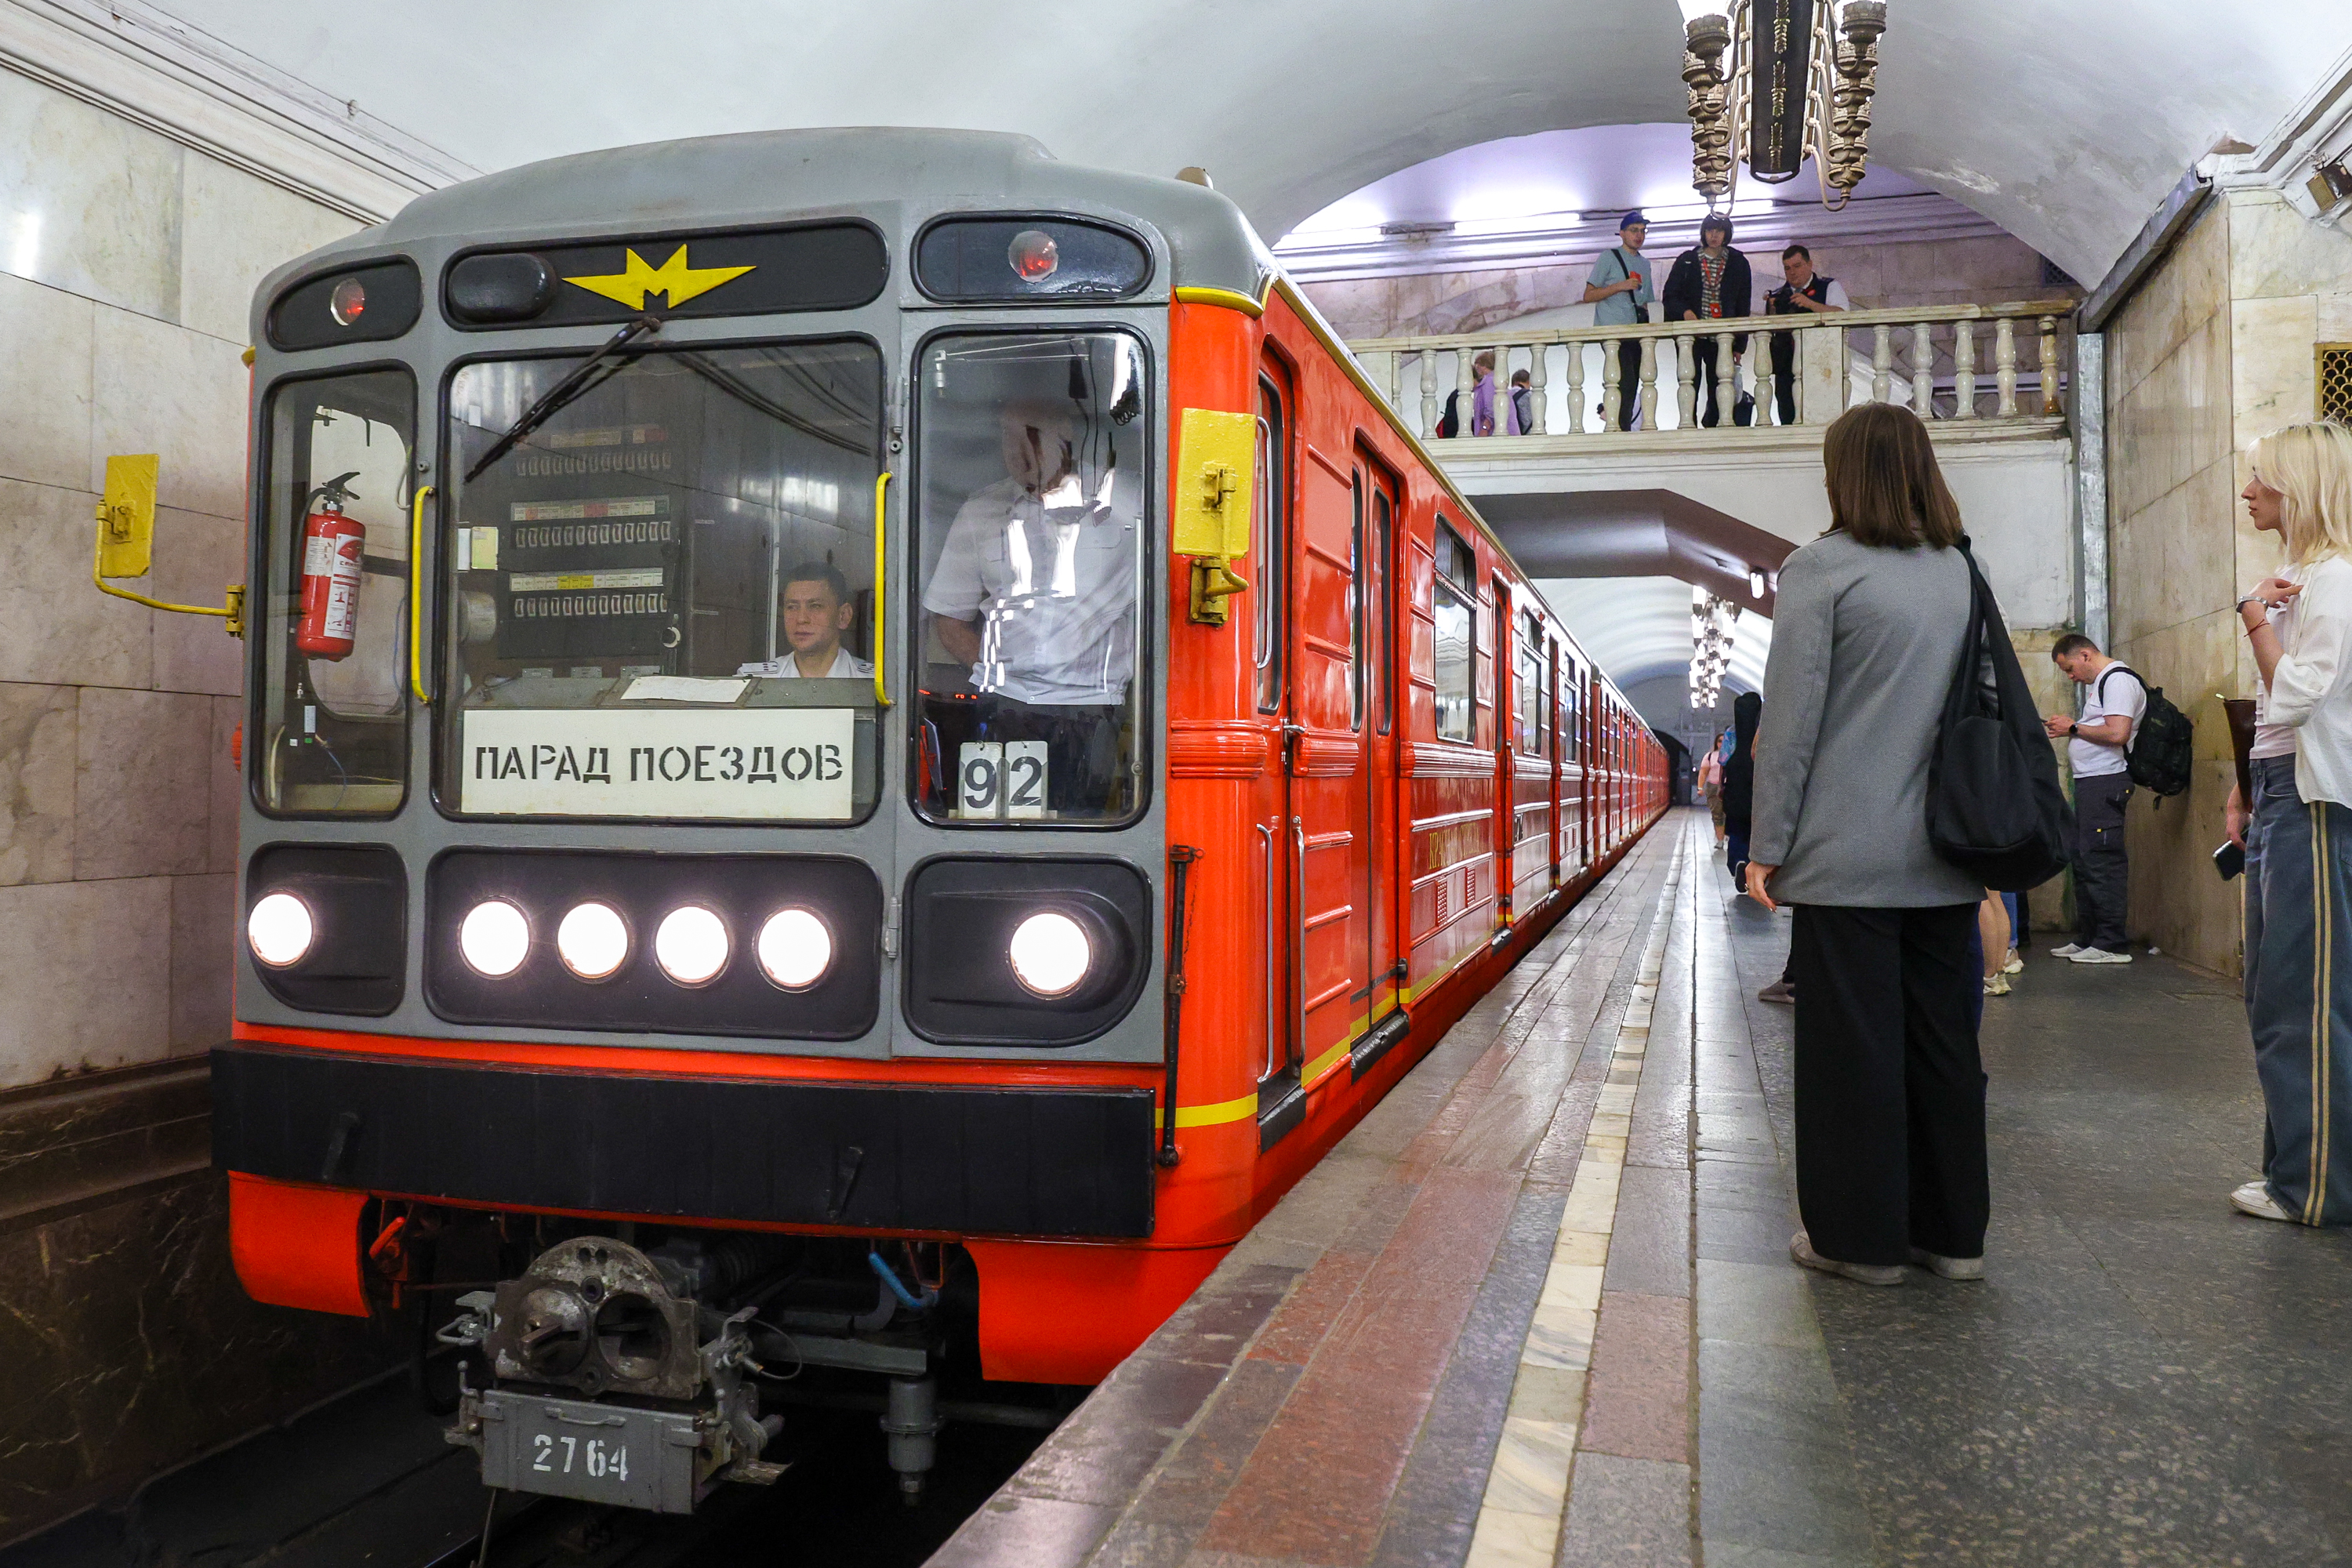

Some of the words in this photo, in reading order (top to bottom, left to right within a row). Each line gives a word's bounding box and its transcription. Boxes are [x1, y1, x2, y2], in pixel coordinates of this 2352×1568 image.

[476, 745, 611, 784] ПАРАД
[630, 745, 843, 784] ПОЕЗДОВ
[964, 756, 1043, 809] 92
[532, 1434, 629, 1482] 2764
